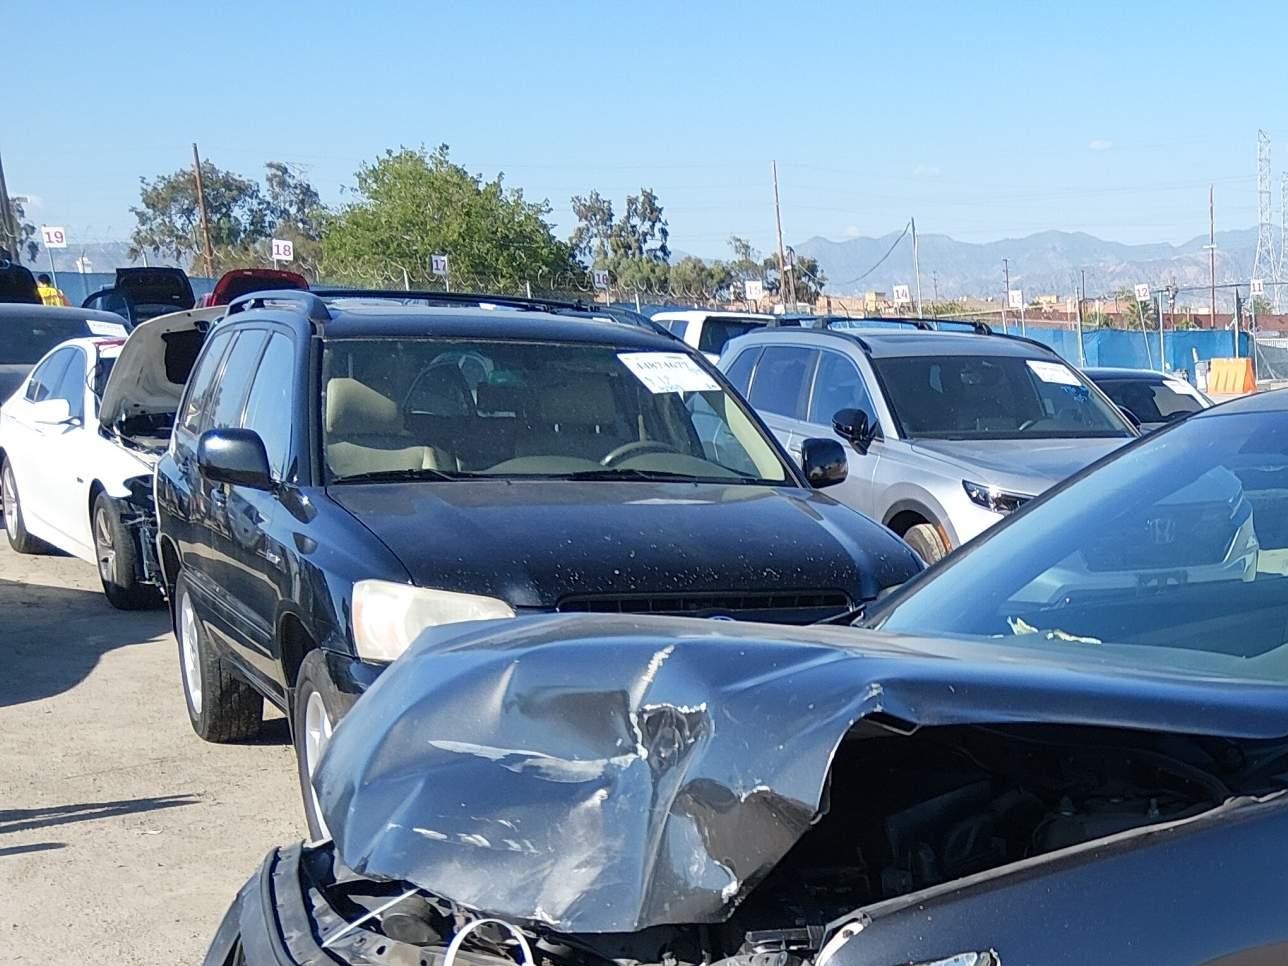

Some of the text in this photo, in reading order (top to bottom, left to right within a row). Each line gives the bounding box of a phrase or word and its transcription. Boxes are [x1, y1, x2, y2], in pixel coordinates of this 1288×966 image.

[45, 231, 64, 244] 19
[274, 243, 292, 256] 18
[433, 258, 447, 271] 17
[1136, 288, 1149, 298] 12
[1252, 282, 1262, 292] 11
[895, 288, 908, 300] 14
